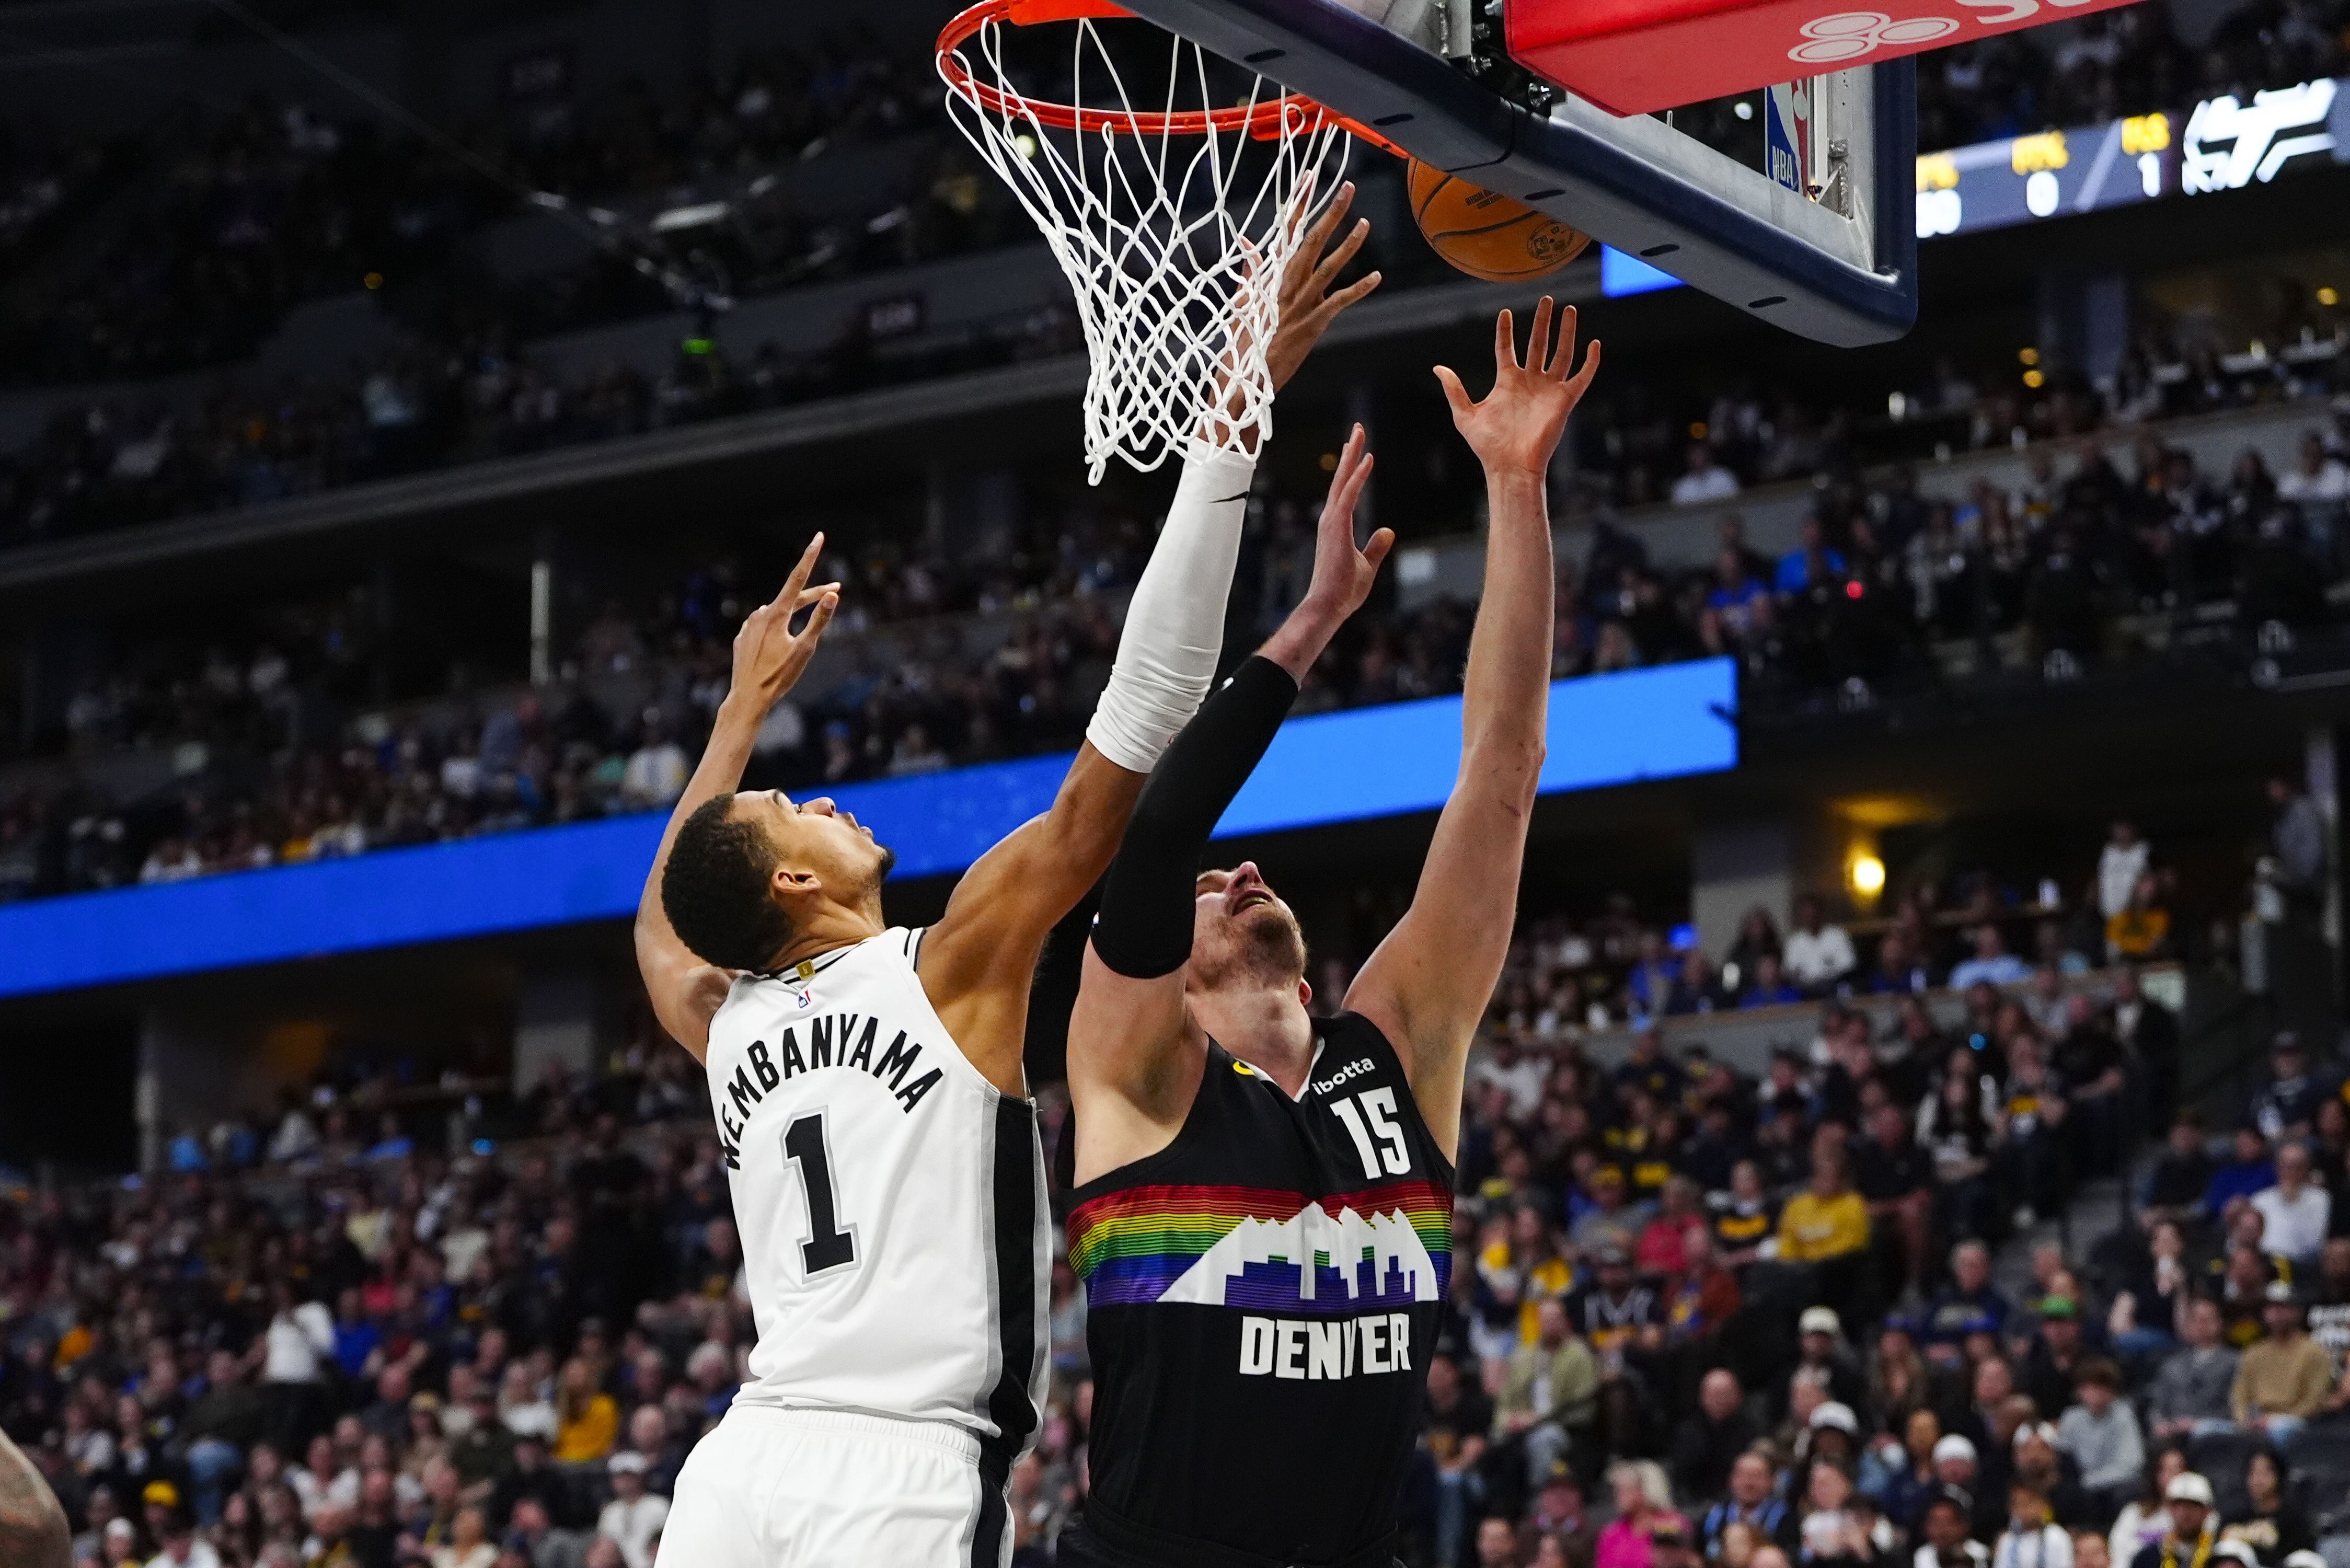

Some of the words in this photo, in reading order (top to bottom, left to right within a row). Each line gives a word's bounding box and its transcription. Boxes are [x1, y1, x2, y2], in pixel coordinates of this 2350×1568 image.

[1772, 145, 1793, 186] NBA
[2138, 151, 2160, 197] 1
[722, 1013, 943, 1170] WEMBANYAMA
[1329, 1086, 1411, 1180] 15
[780, 1105, 861, 1284] 1
[1239, 1313, 1412, 1380] DENVER
